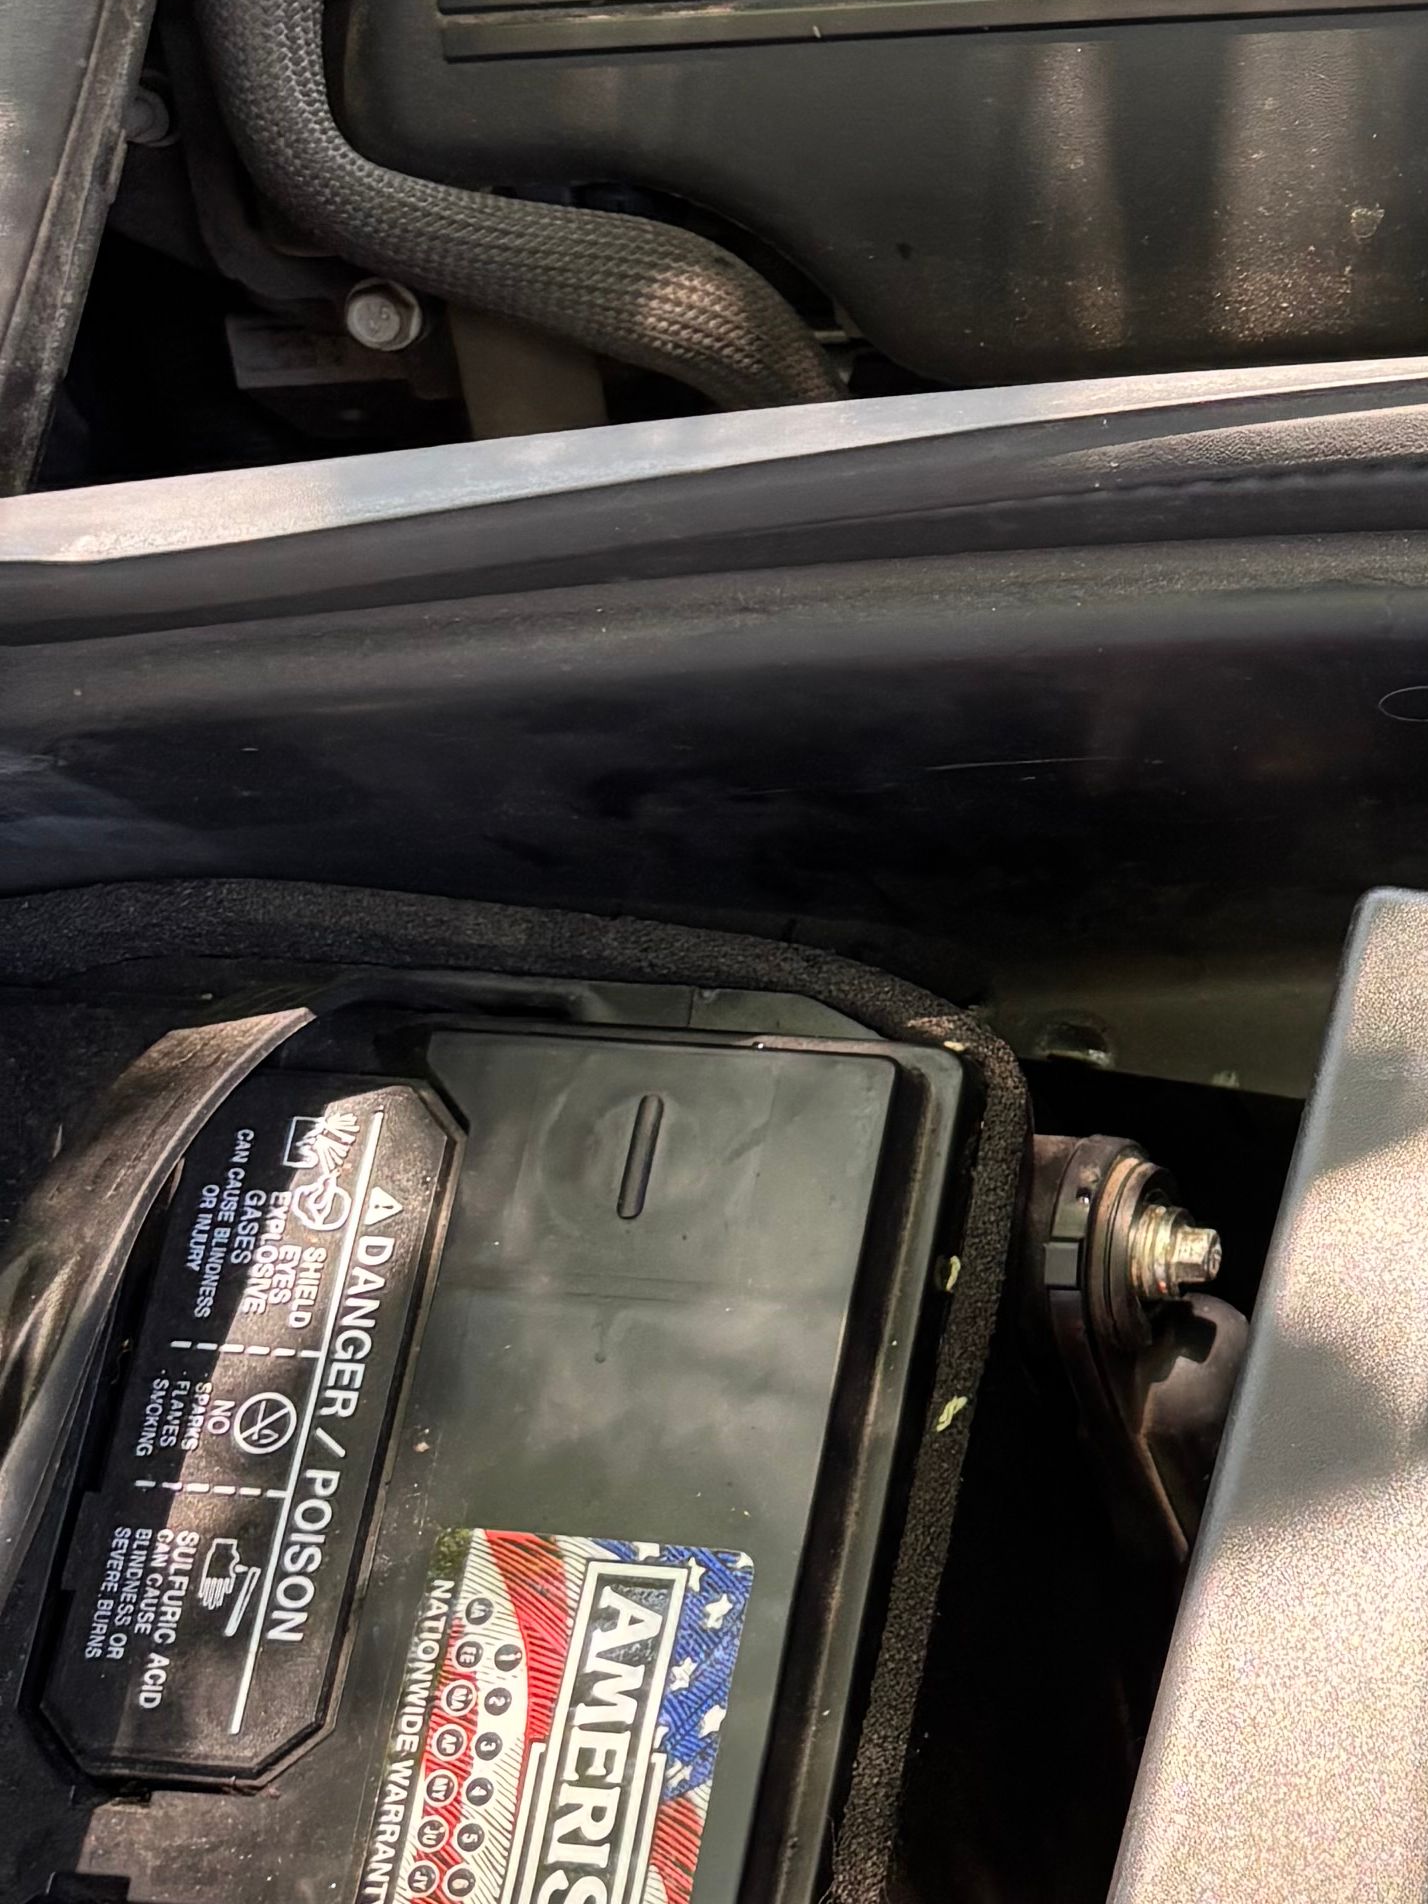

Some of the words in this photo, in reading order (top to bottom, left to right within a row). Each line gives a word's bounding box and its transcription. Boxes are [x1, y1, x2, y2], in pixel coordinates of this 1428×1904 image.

[229, 1188, 267, 1264] GASES
[239, 1190, 292, 1316] EXPLOSIVE
[266, 1244, 302, 1304] EYES
[286, 1246, 327, 1328] SHIELD
[317, 1235, 395, 1418] DANGER
[205, 1398, 235, 1434] NO
[313, 1426, 346, 1458] /
[151, 1529, 200, 1644] SULFURIC
[265, 1468, 341, 1642] POISON
[137, 1651, 170, 1709] ACID
[392, 1579, 454, 1755] NATIONWIDE
